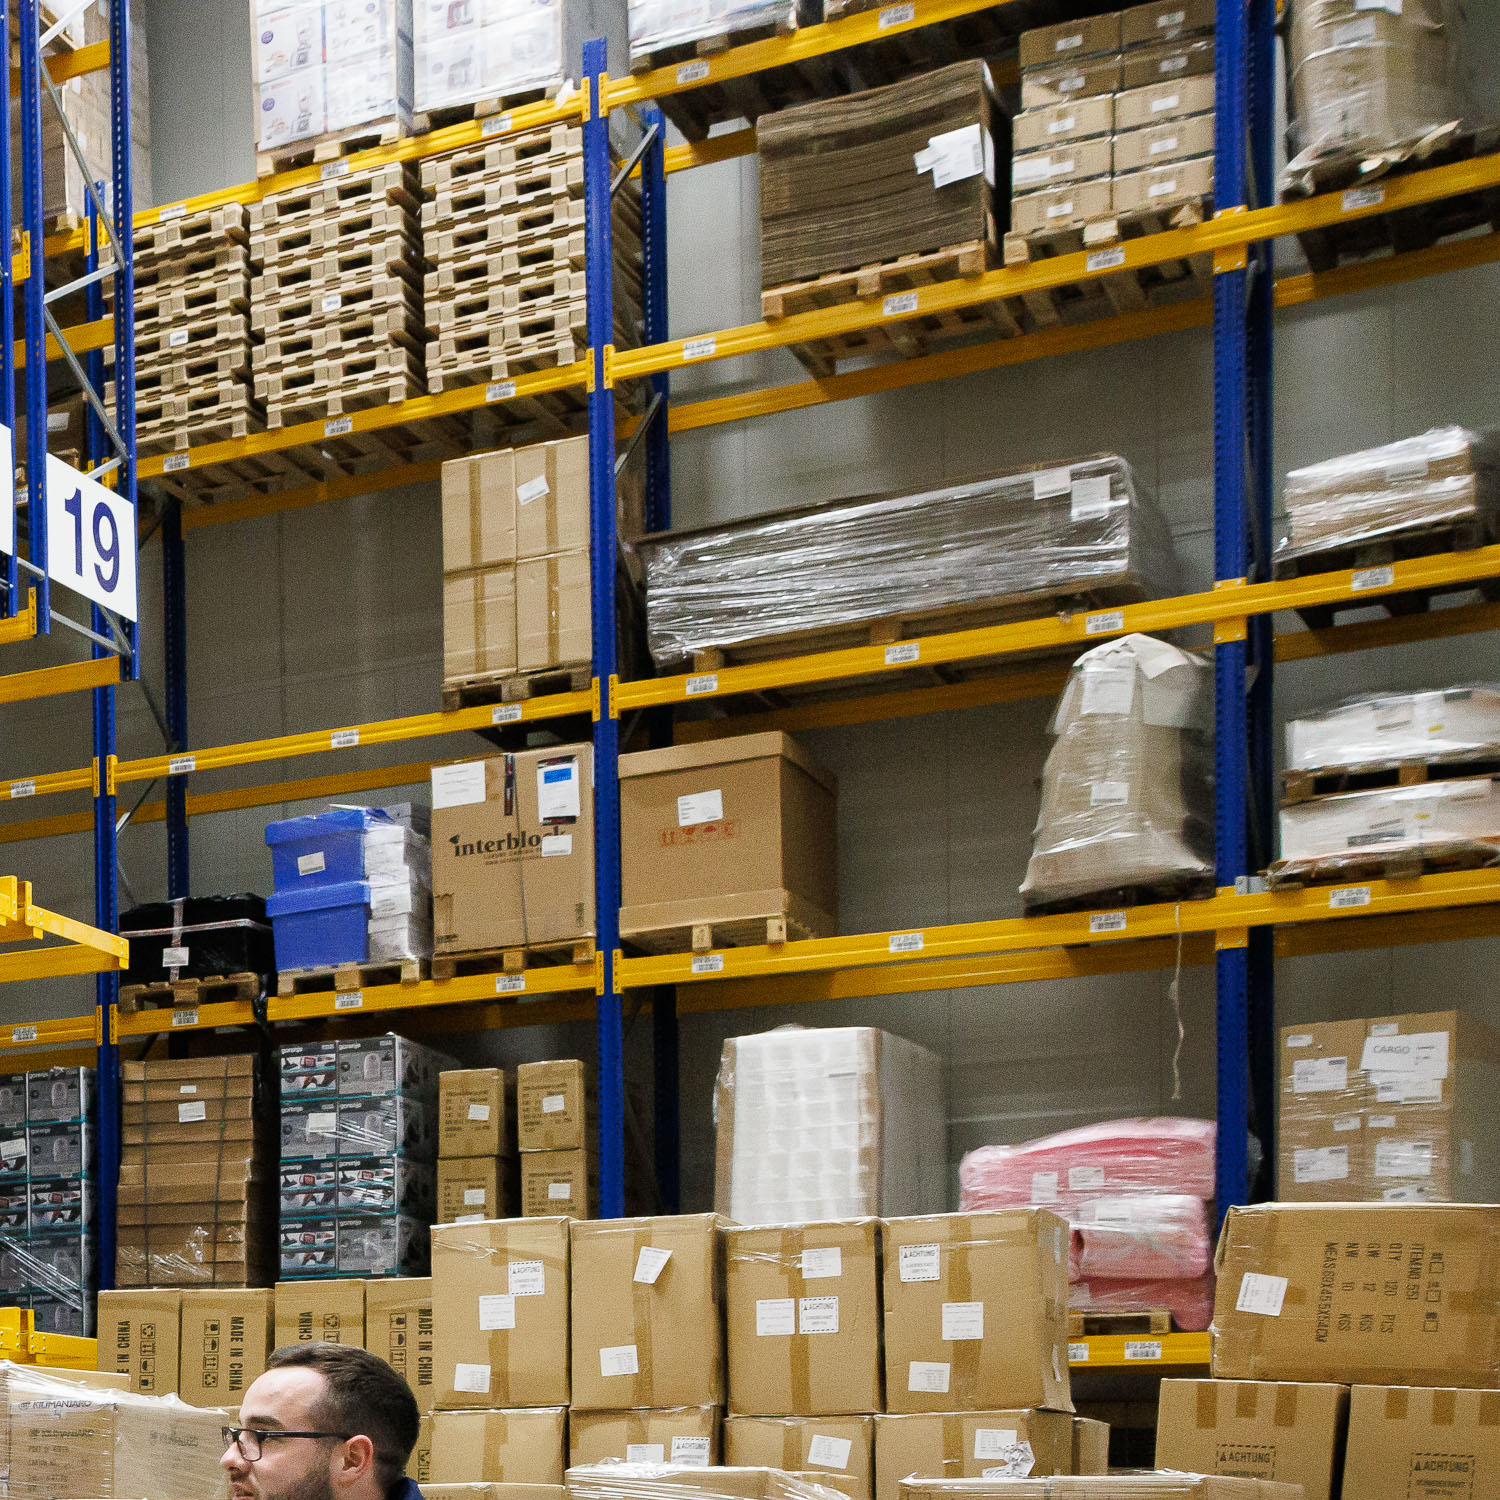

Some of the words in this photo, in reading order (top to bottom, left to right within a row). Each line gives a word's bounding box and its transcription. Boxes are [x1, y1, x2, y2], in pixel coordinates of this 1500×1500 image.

[65, 488, 120, 593] 19
[1373, 1044, 1410, 1055] CARGO
[908, 1249, 936, 1258] ACHTUNG
[1348, 1242, 1359, 1258] NW
[516, 1266, 541, 1275] ACHTUNG
[1346, 1281, 1355, 1292] 10
[1367, 1281, 1376, 1293] 12
[1384, 1280, 1397, 1296] 120
[808, 1302, 835, 1311] ACHTUNG
[299, 1311, 312, 1340] CHINA
[418, 1309, 432, 1335] MADE
[117, 1321, 130, 1349] CHINA
[229, 1317, 243, 1342] MADE
[418, 1342, 432, 1351] IN
[117, 1354, 130, 1364] IN
[229, 1349, 243, 1357] IN
[229, 1364, 243, 1391] CHINA
[418, 1357, 432, 1386] CHINA
[32, 1400, 92, 1409] KILIMANJARO
[680, 1443, 706, 1451] ACHTUNG
[1228, 1451, 1271, 1464] ACHTUNG
[1423, 1460, 1469, 1473] ACHTUNG
